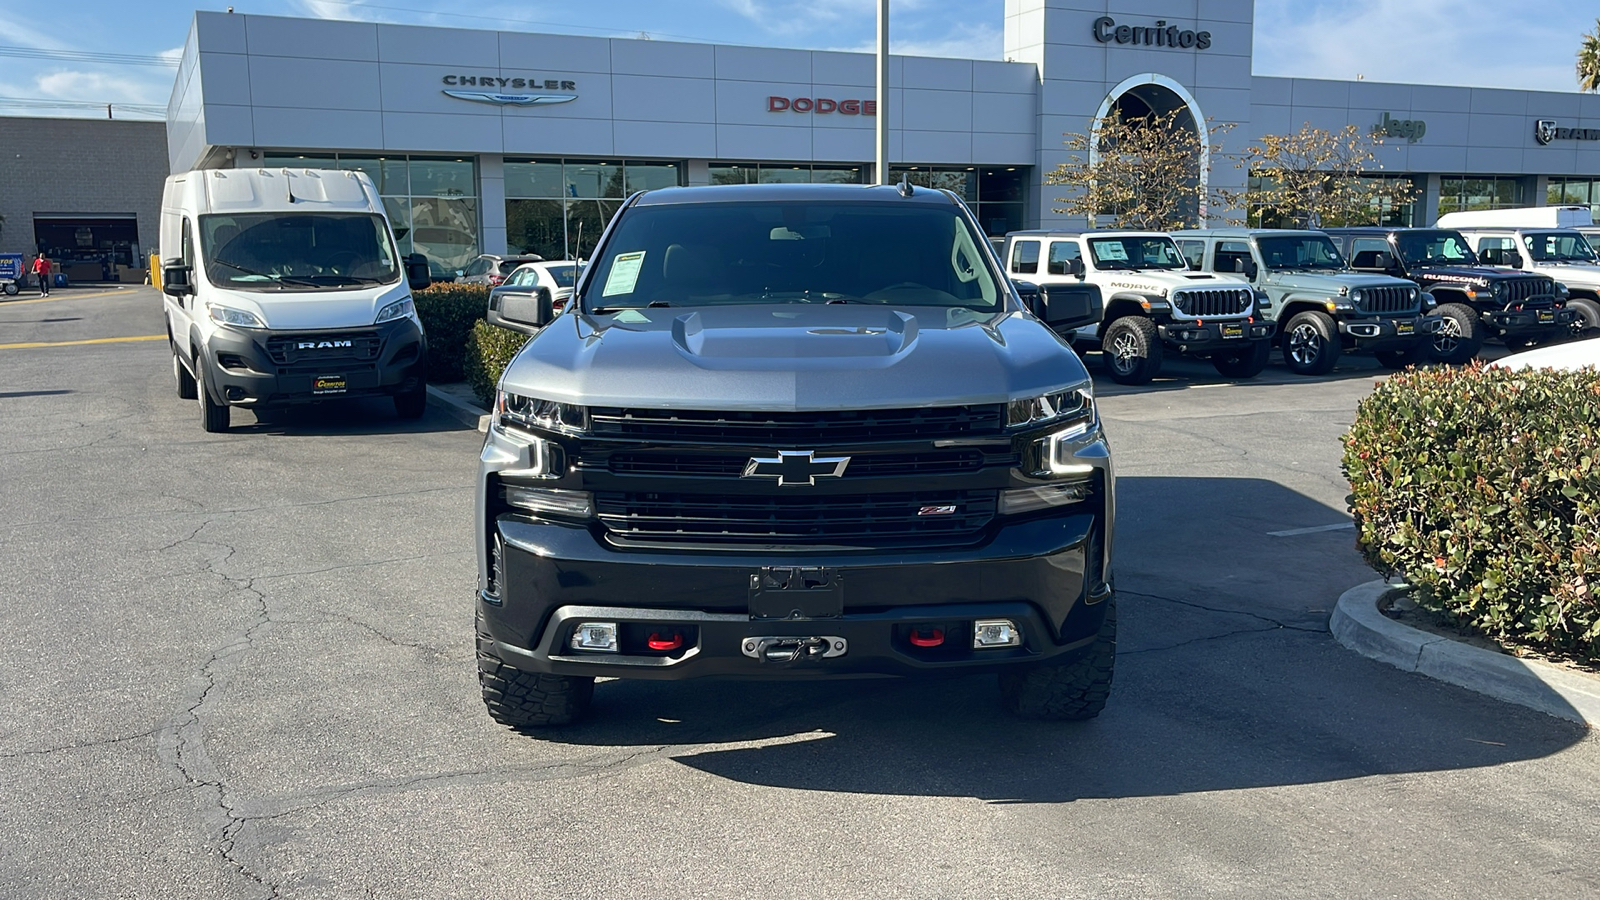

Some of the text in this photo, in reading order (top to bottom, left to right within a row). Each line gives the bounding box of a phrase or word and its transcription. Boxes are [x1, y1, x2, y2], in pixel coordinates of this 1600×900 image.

[1093, 16, 1212, 49] Cerritos
[442, 75, 576, 90] CHRYSLER
[768, 96, 877, 116] DODGE
[1555, 127, 1600, 140] RAM
[1423, 274, 1480, 285] RUBICON
[1110, 282, 1159, 291] MOJAVE
[298, 340, 352, 349] RAM
[917, 505, 957, 516] Z71
